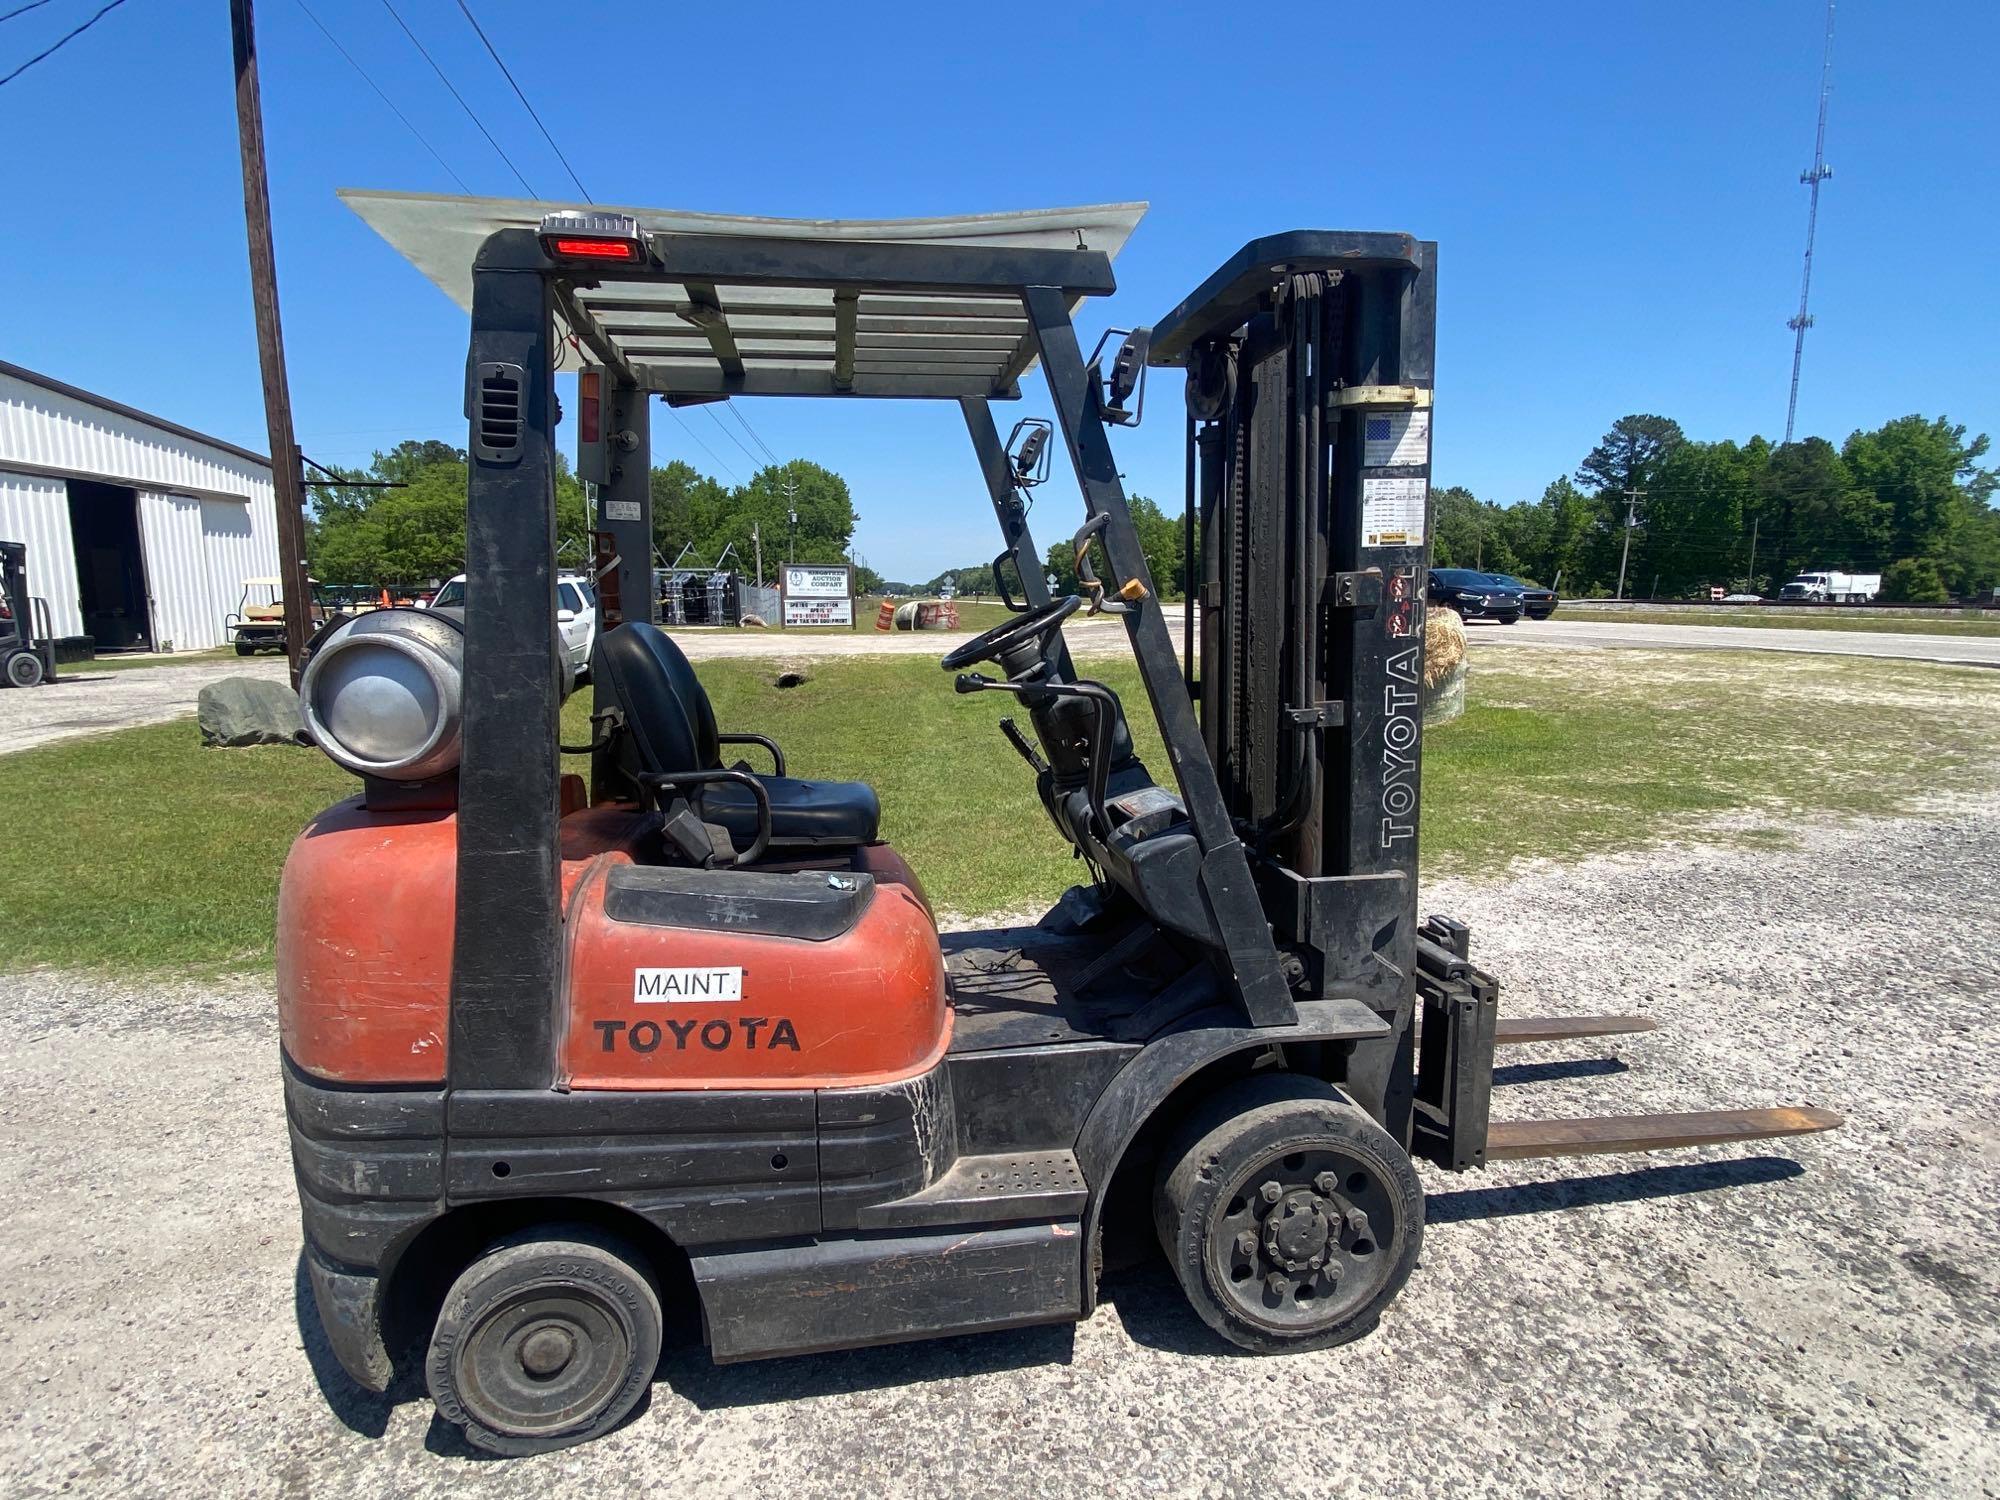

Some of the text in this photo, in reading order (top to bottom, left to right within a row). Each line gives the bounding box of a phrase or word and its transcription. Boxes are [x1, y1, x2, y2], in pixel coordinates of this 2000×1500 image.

[1381, 645, 1419, 848] TOYOTA
[638, 972, 737, 996] MAINT.
[593, 1019, 801, 1053] TOYOTA
[1356, 1129, 1417, 1201] MONARCH
[434, 1333, 474, 1430] MONARCH
